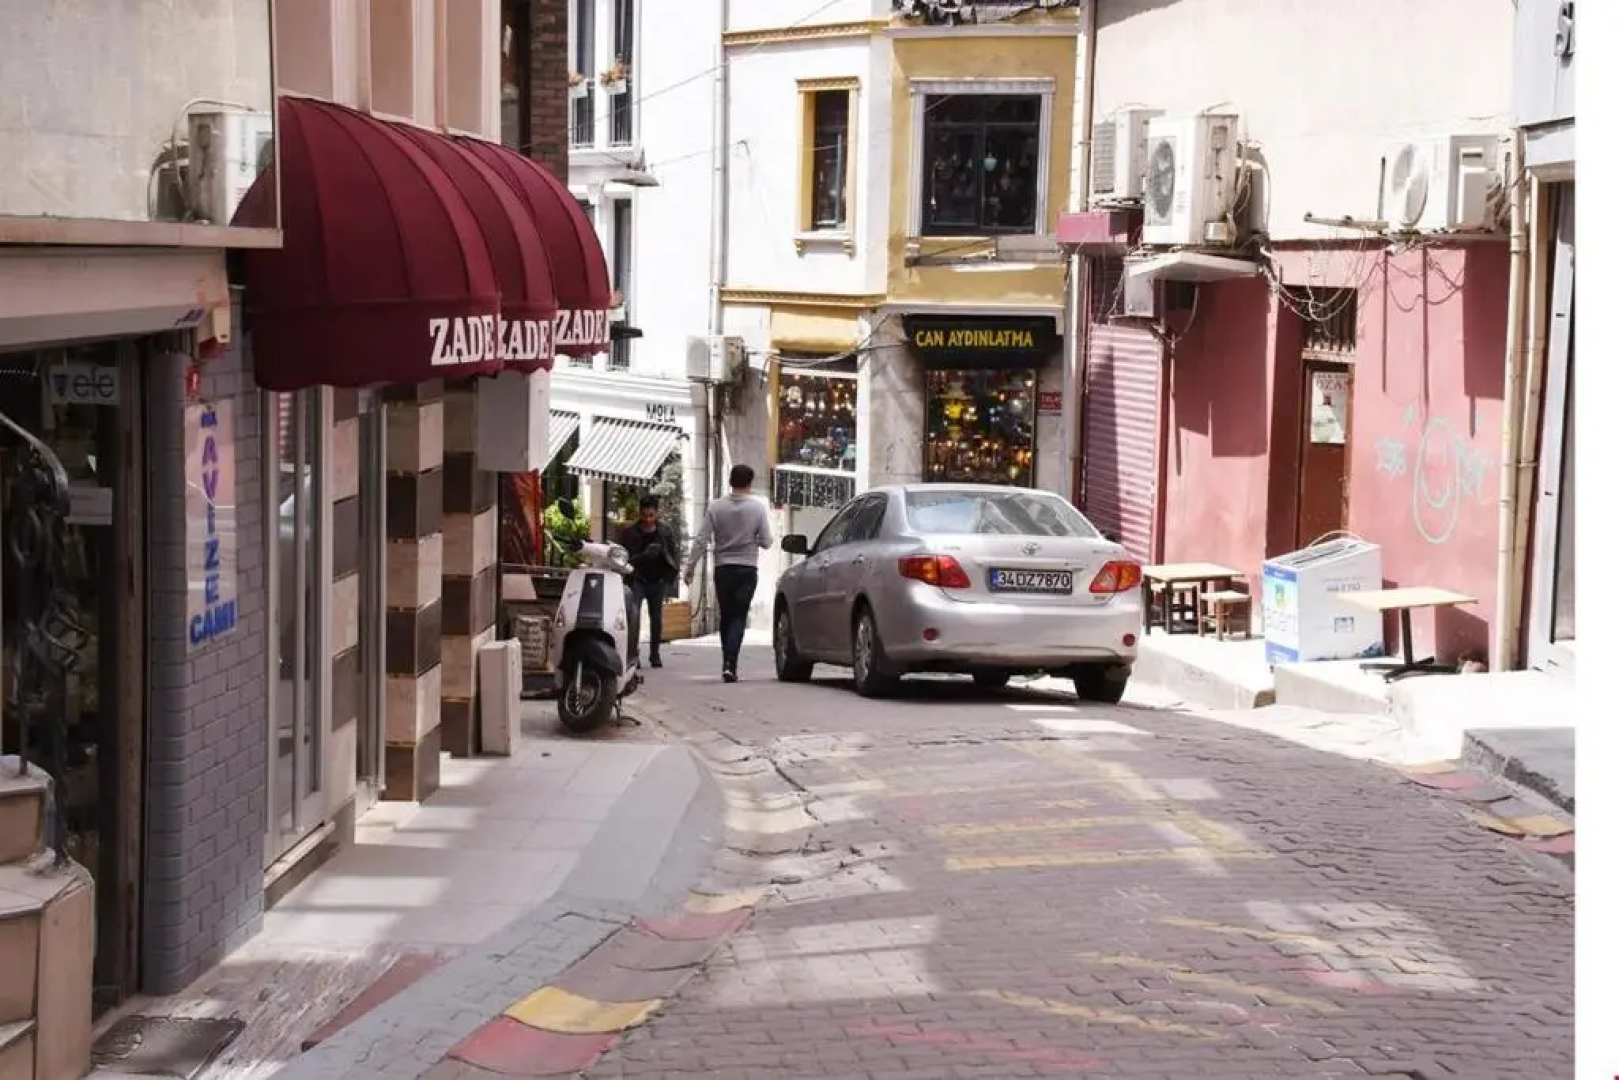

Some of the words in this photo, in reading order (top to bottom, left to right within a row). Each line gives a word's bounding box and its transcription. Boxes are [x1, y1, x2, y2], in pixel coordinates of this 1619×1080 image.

[429, 314, 501, 366] ZADE
[497, 320, 556, 360] ZADE
[916, 330, 943, 347] CAN
[949, 330, 1034, 347] AYDINLATMA
